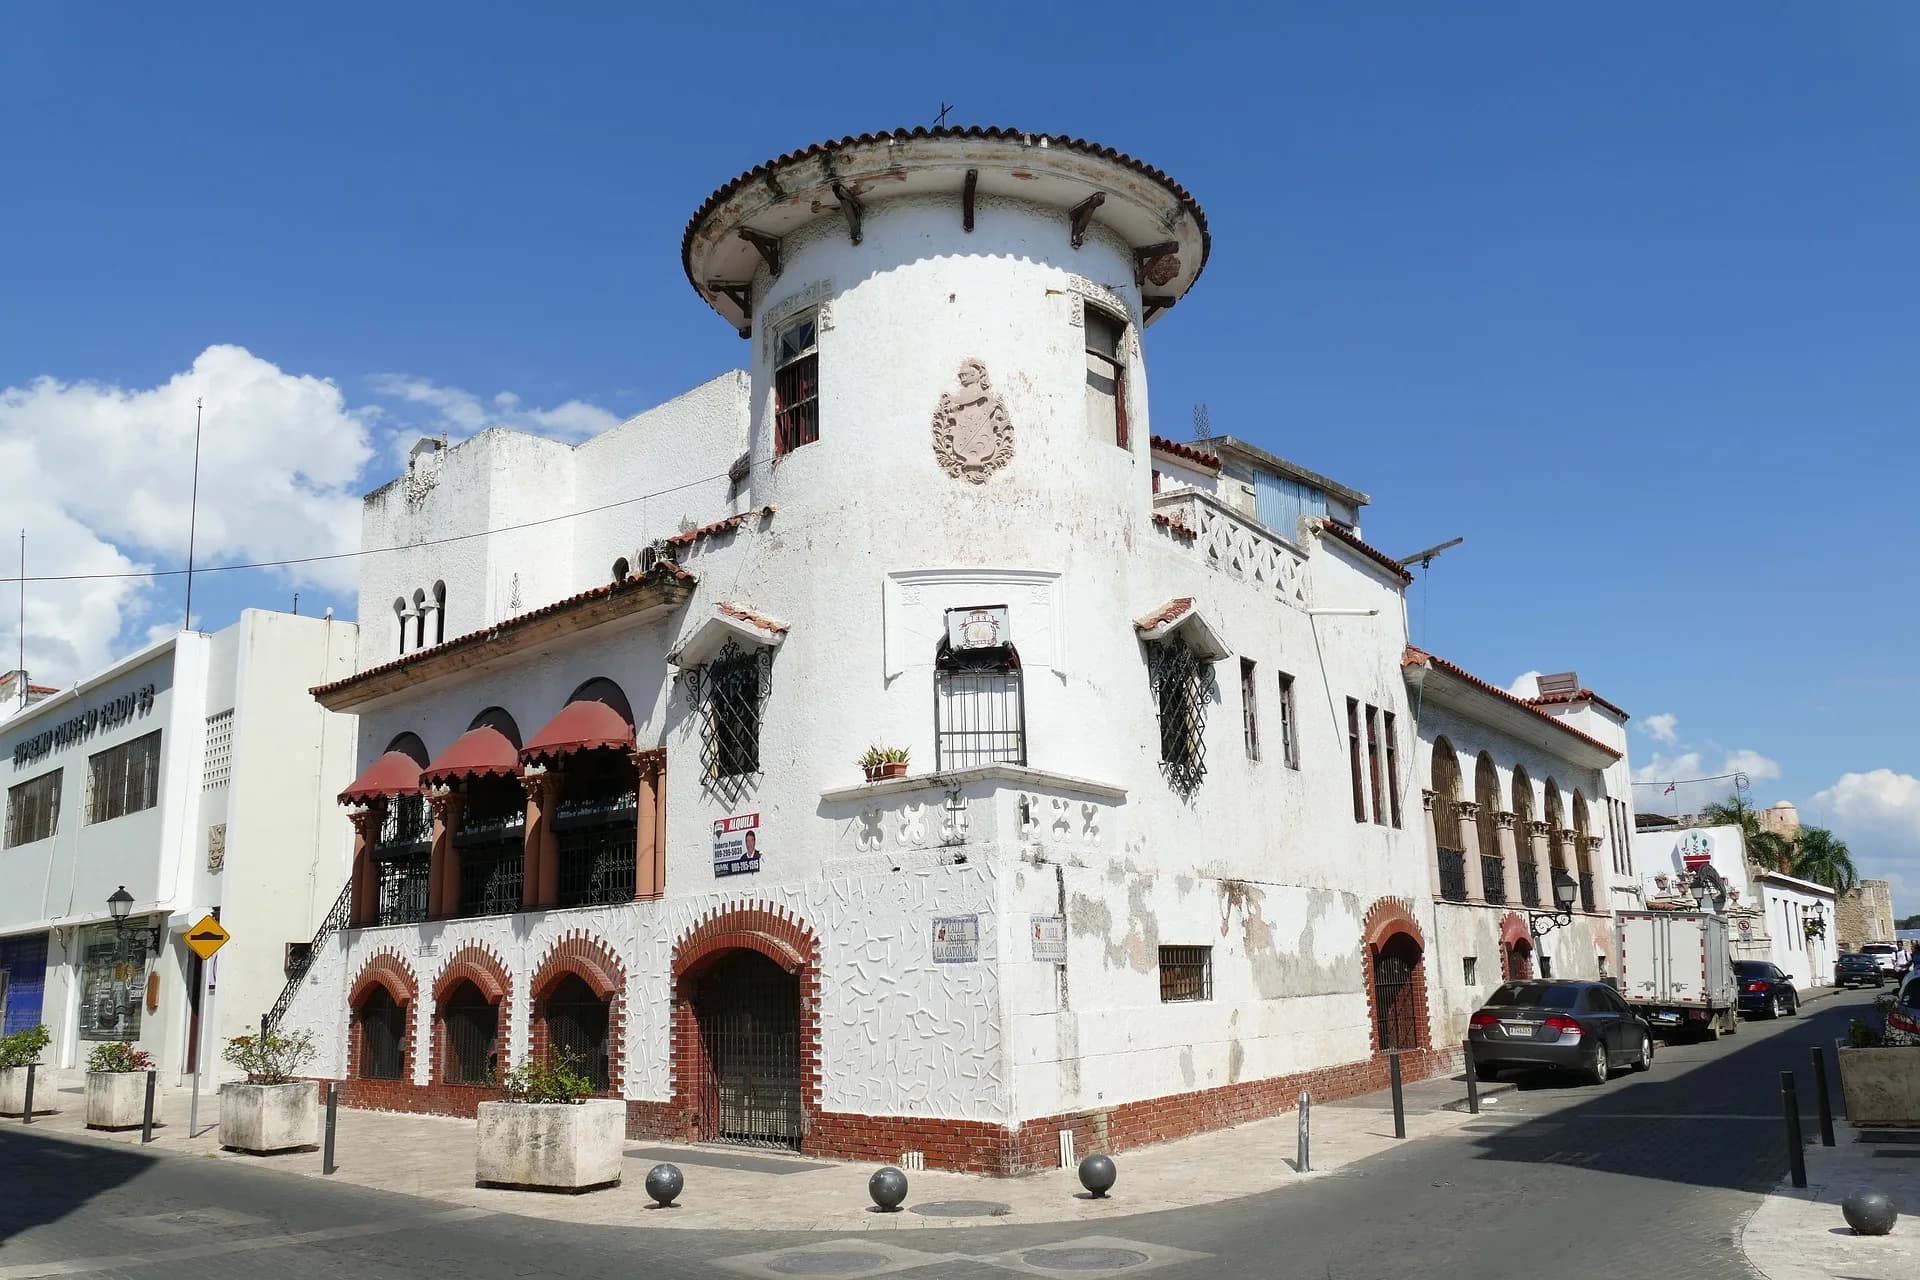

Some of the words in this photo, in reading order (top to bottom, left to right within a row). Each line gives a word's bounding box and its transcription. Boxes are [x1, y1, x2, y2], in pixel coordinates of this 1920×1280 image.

[13, 730, 53, 766] SUPREMO
[55, 708, 98, 747] CONSEJO
[100, 692, 136, 728] GRADO
[728, 815, 754, 831] ALQUILA
[947, 923, 965, 934] CALLE
[936, 947, 945, 958] LA
